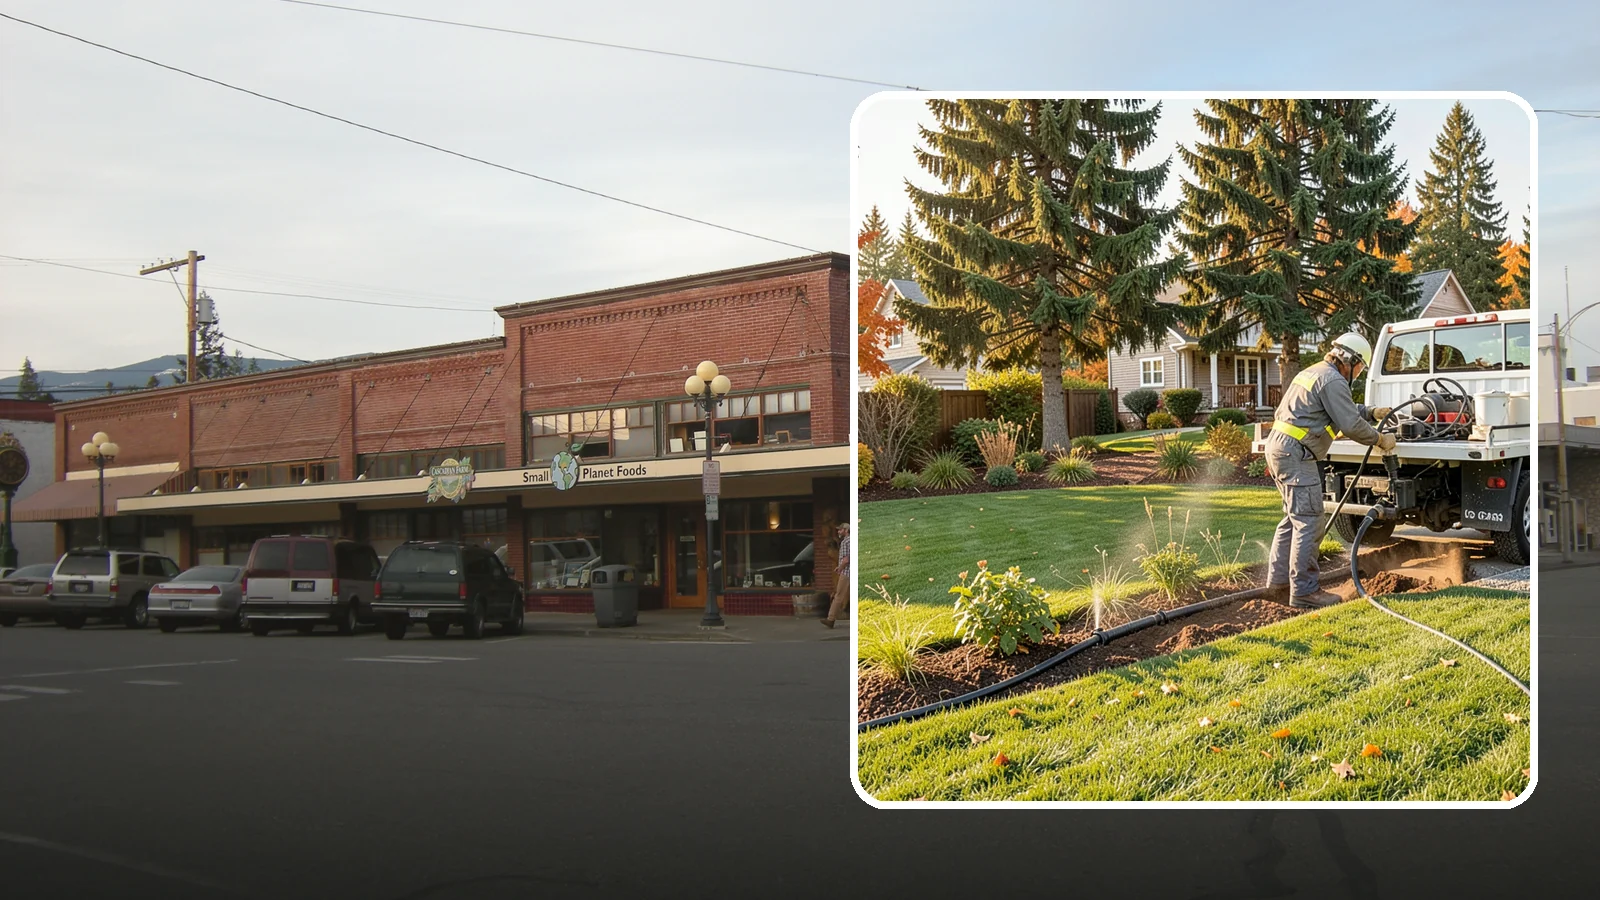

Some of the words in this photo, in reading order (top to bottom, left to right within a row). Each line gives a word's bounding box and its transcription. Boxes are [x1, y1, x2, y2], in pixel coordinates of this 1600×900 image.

[523, 471, 549, 483] Small
[583, 467, 614, 479] Planet
[617, 464, 647, 477] Foods
